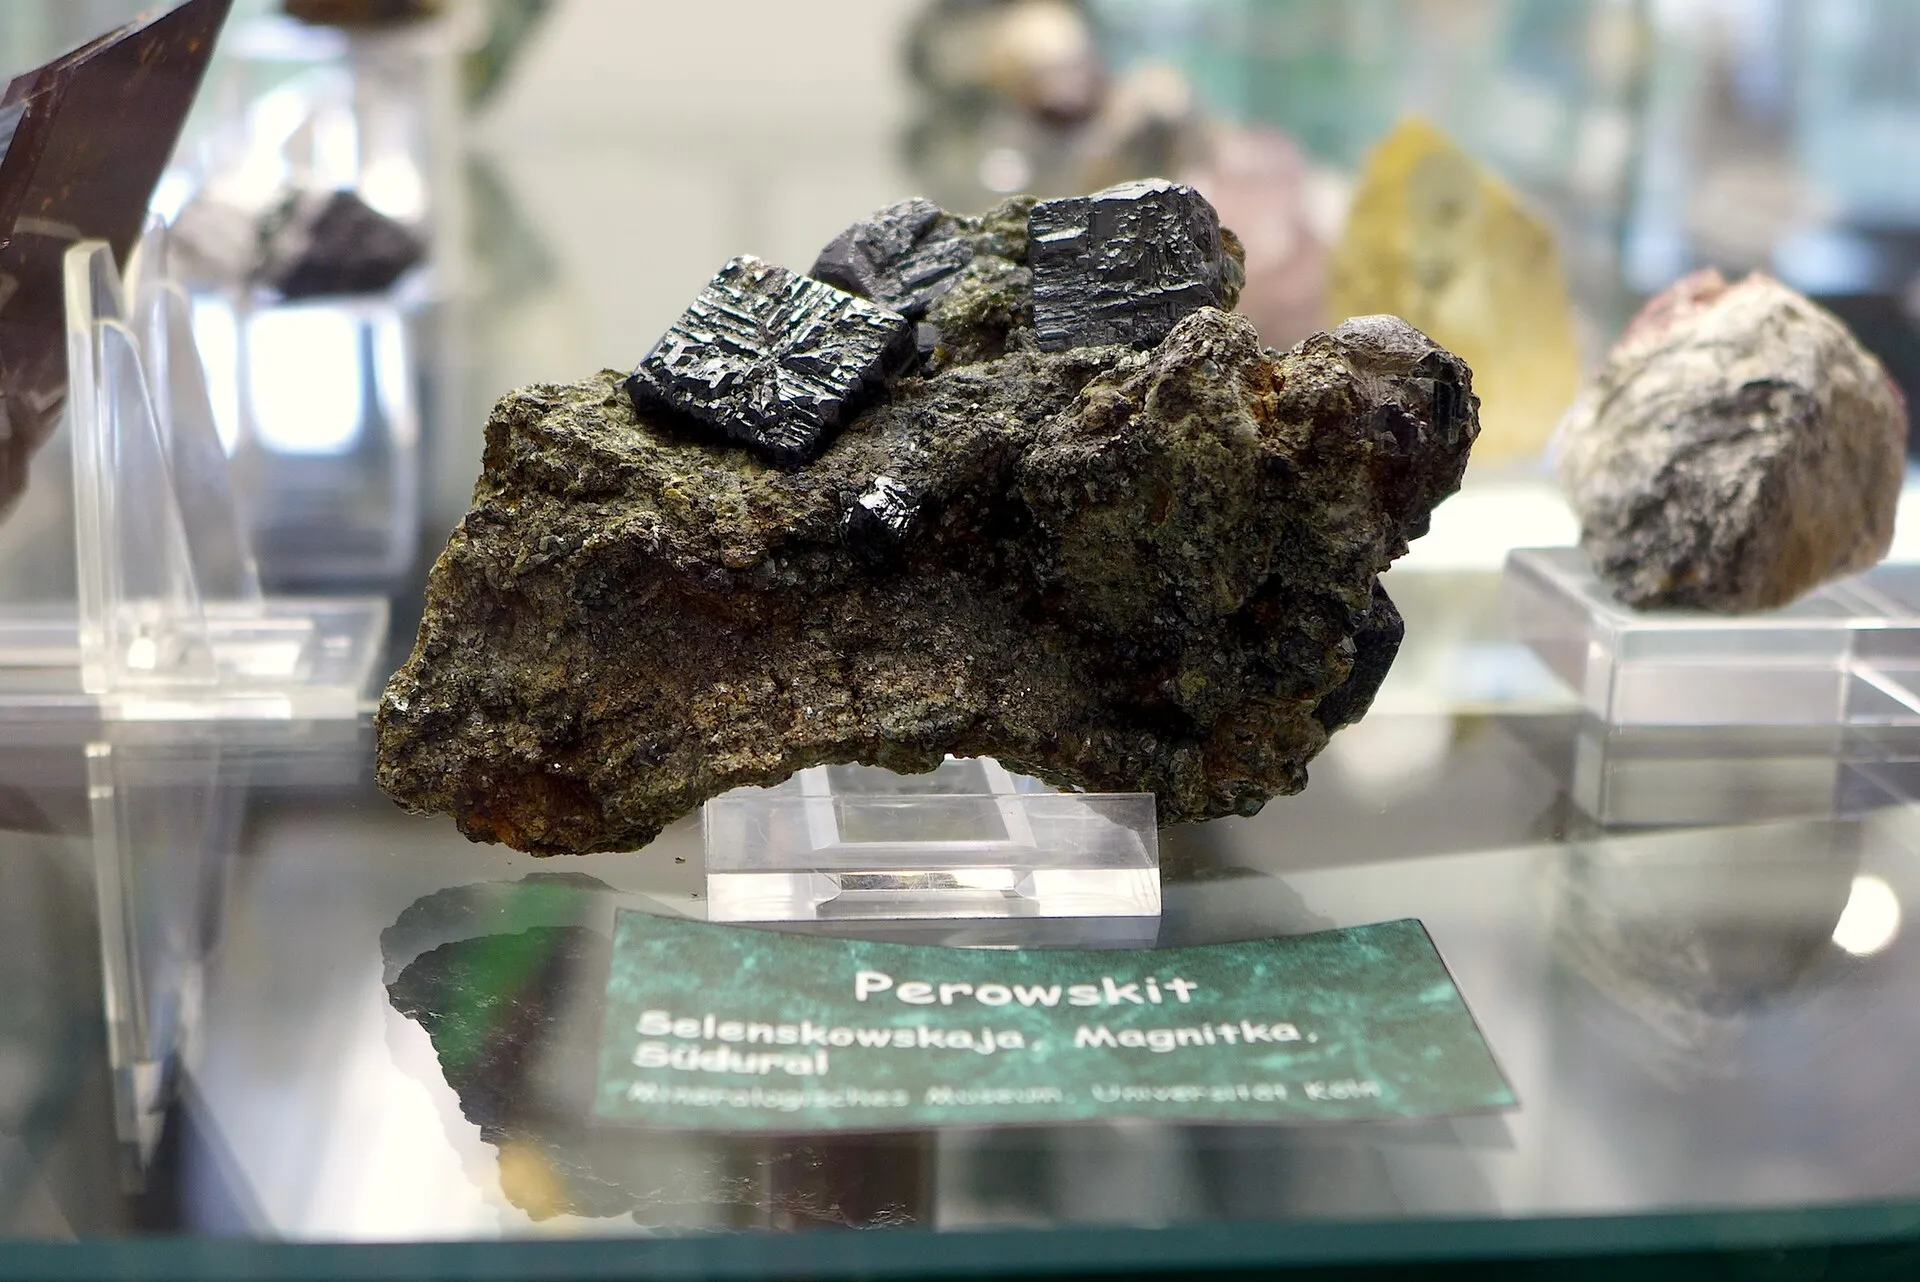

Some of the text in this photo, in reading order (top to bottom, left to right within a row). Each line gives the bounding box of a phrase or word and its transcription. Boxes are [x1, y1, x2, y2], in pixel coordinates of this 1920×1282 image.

[855, 969, 1199, 1008] Perowskit
[631, 1039, 830, 1077] Südural
[628, 1080, 910, 1111] Mineralogisches
